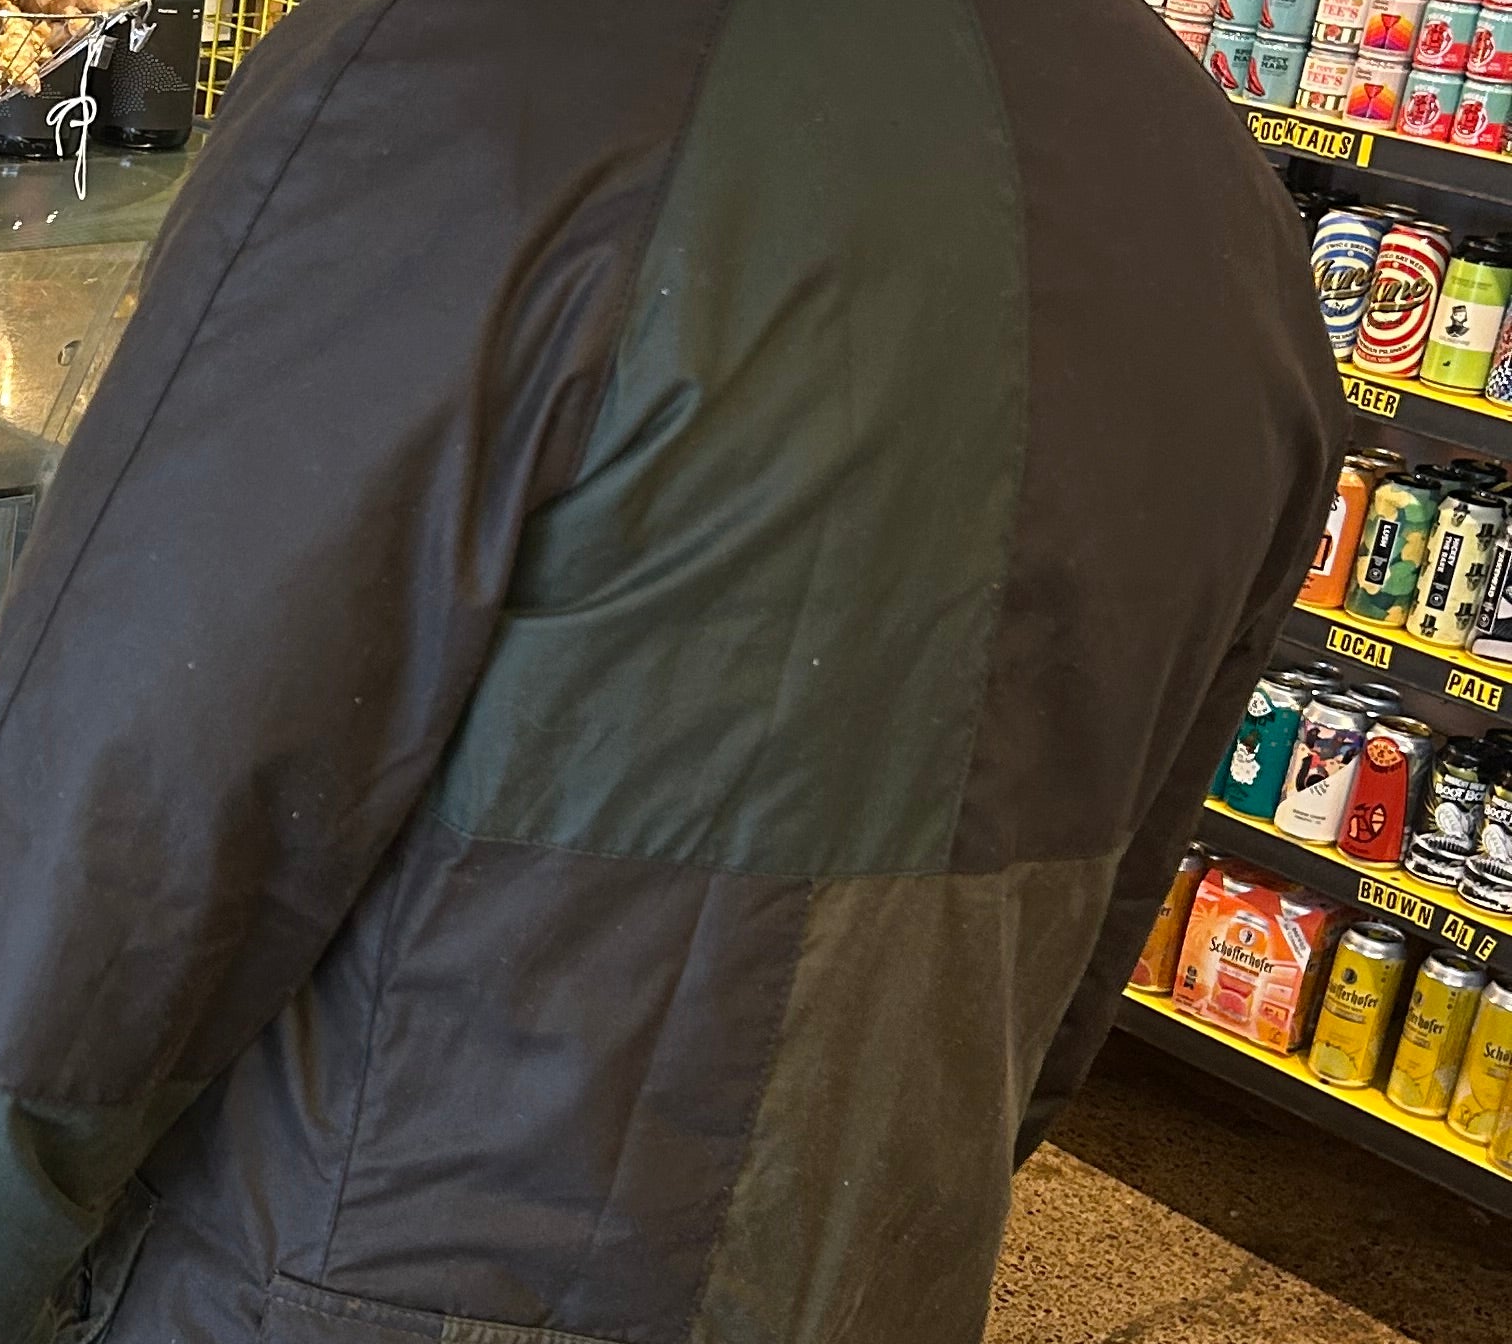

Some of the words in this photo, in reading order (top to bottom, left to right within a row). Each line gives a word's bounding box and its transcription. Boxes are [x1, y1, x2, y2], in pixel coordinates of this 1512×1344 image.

[1249, 115, 1352, 156] COCKTAILS
[1349, 384, 1397, 414] AGER
[1328, 628, 1389, 667] LOCAL
[1449, 672, 1500, 709] PALE
[1360, 881, 1433, 926] BROWN
